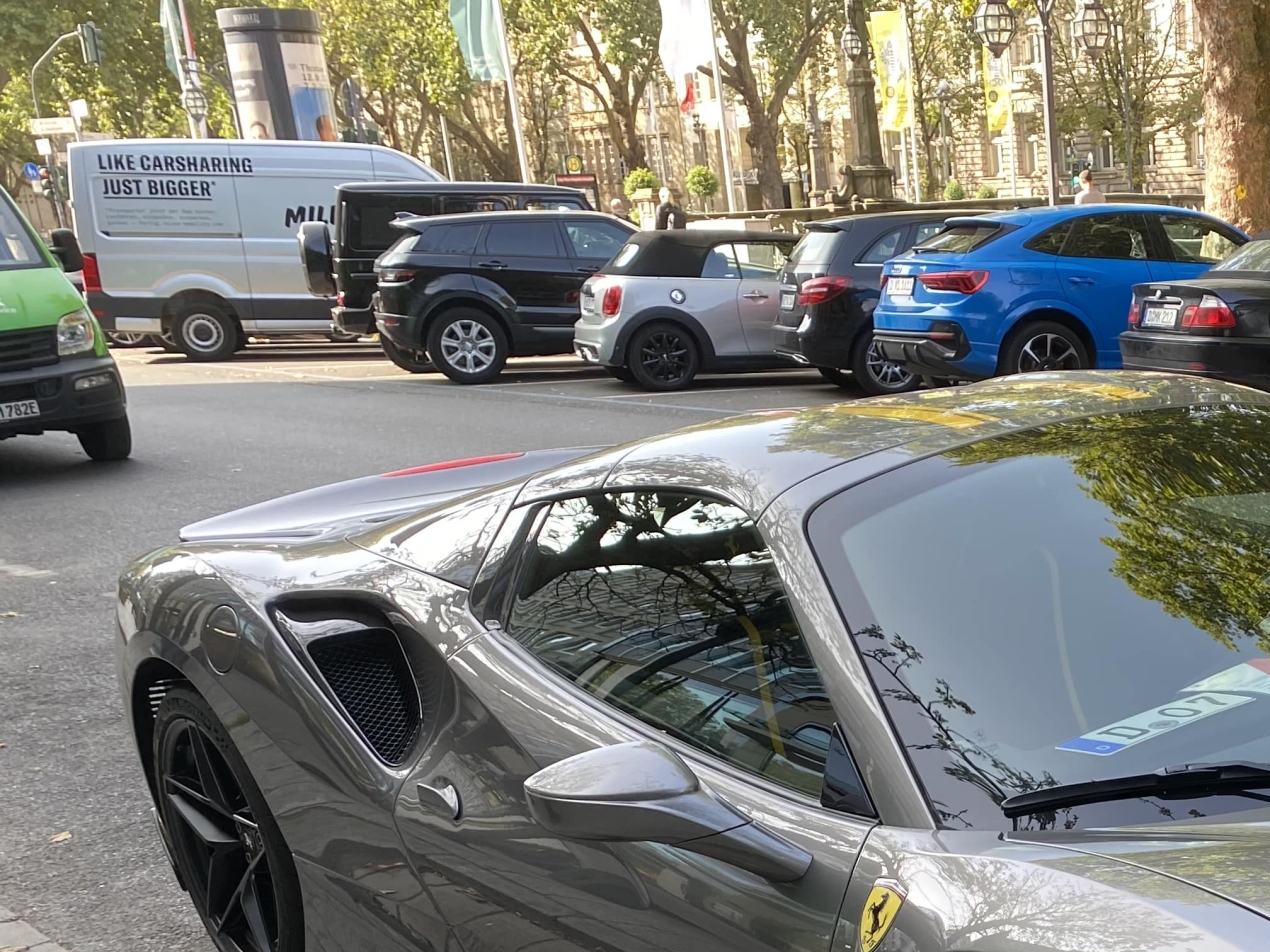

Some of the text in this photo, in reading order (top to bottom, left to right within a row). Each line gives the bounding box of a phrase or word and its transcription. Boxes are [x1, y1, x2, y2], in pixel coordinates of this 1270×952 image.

[97, 154, 254, 173] LIKE CARSHARING
[103, 178, 142, 195] JUST
[1097, 725, 1151, 740] D
